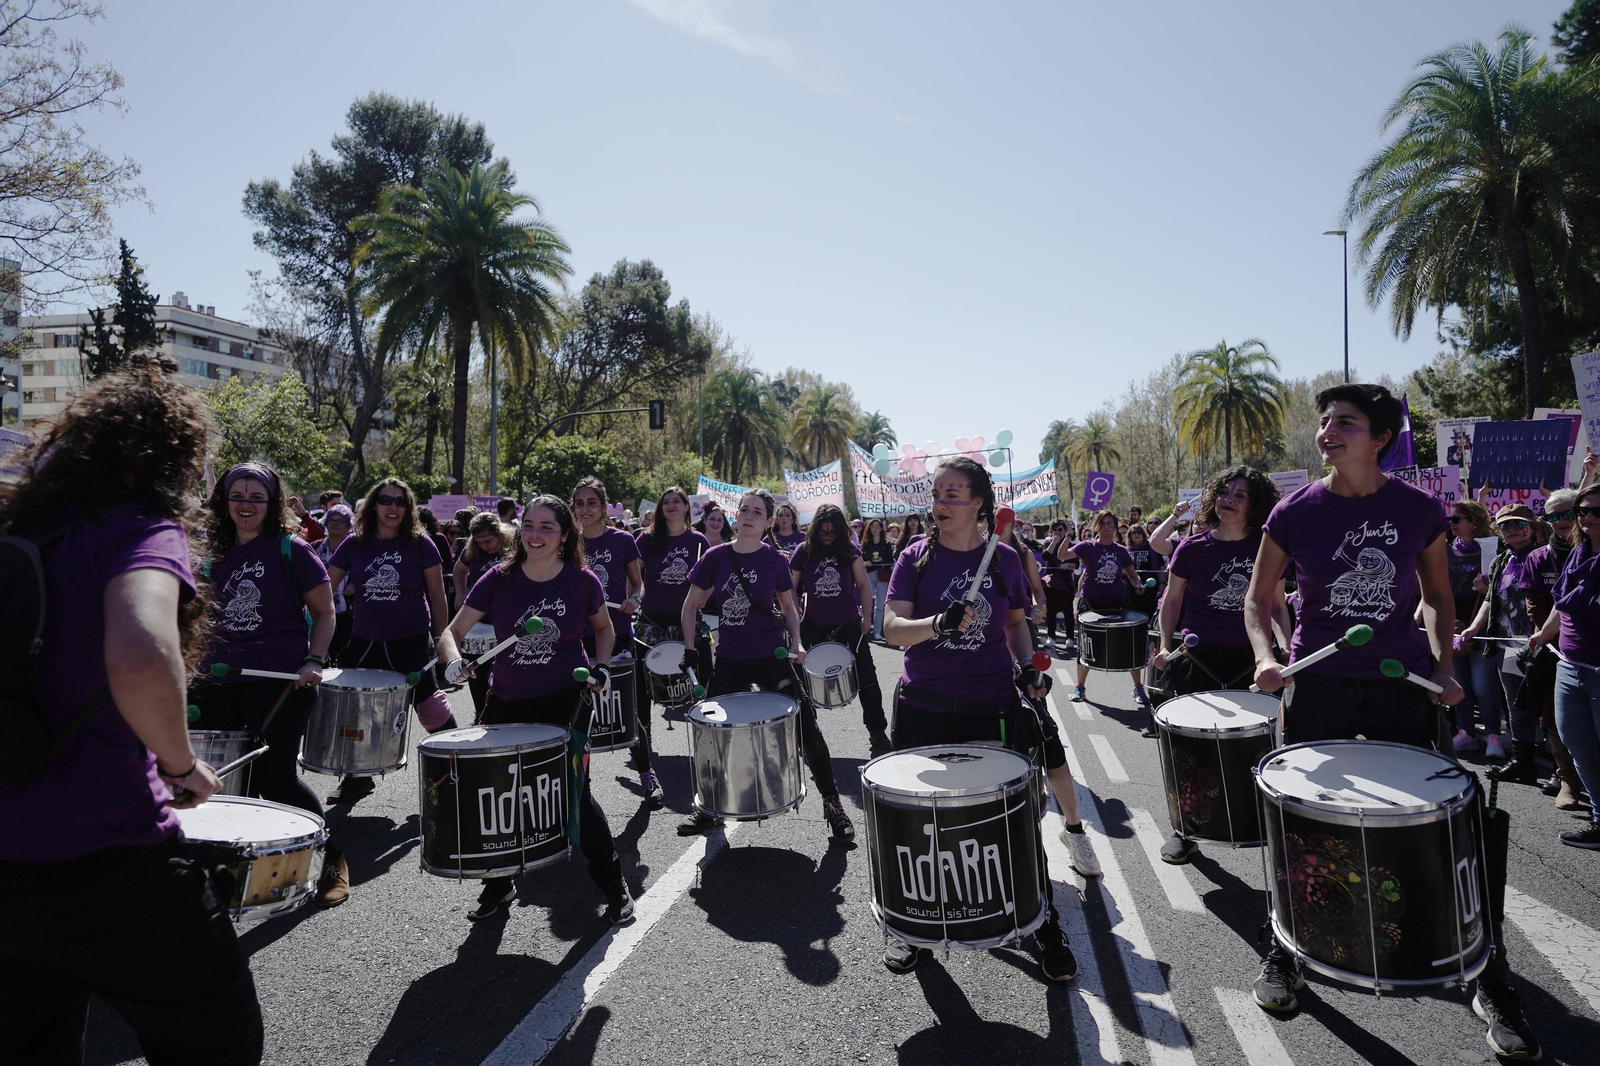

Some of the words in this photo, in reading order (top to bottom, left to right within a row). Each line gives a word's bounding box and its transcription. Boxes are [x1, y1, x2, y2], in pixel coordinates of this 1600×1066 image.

[1394, 469, 1432, 481] SOMOS
[1434, 467, 1447, 478] EL
[795, 483, 843, 500] CORDOBA
[483, 836, 517, 851] sound
[523, 831, 550, 846] sister
[906, 905, 940, 918] sound
[946, 905, 984, 919] sister
